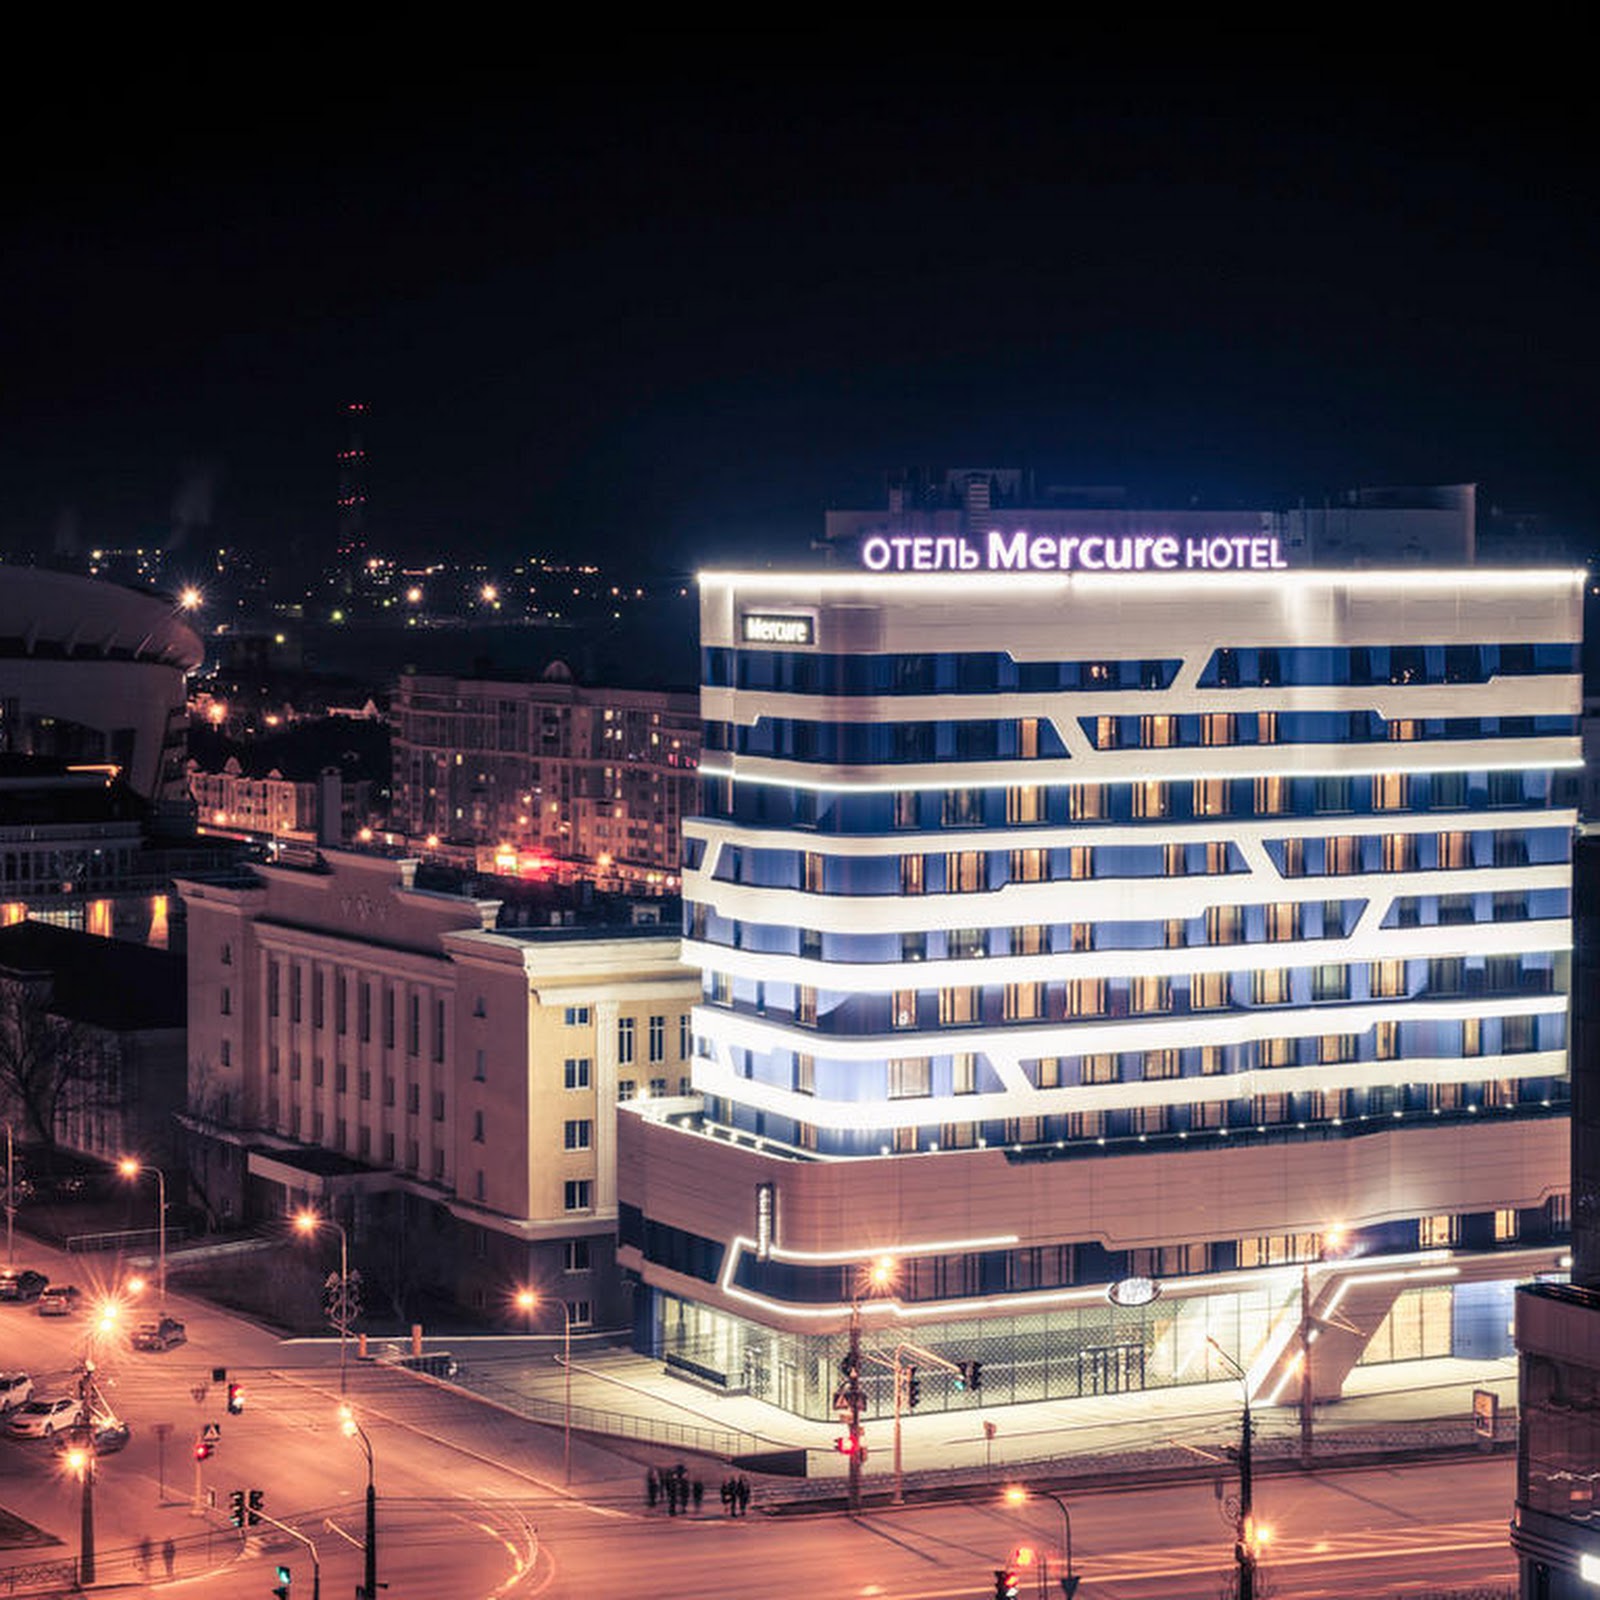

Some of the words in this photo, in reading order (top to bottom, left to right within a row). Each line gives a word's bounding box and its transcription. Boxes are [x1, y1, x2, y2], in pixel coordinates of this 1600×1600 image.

[863, 538, 979, 570] ОТЕЛЬ
[988, 532, 1178, 569] Mercure
[1186, 538, 1287, 569] HOTEL
[746, 616, 808, 642] Mercure
